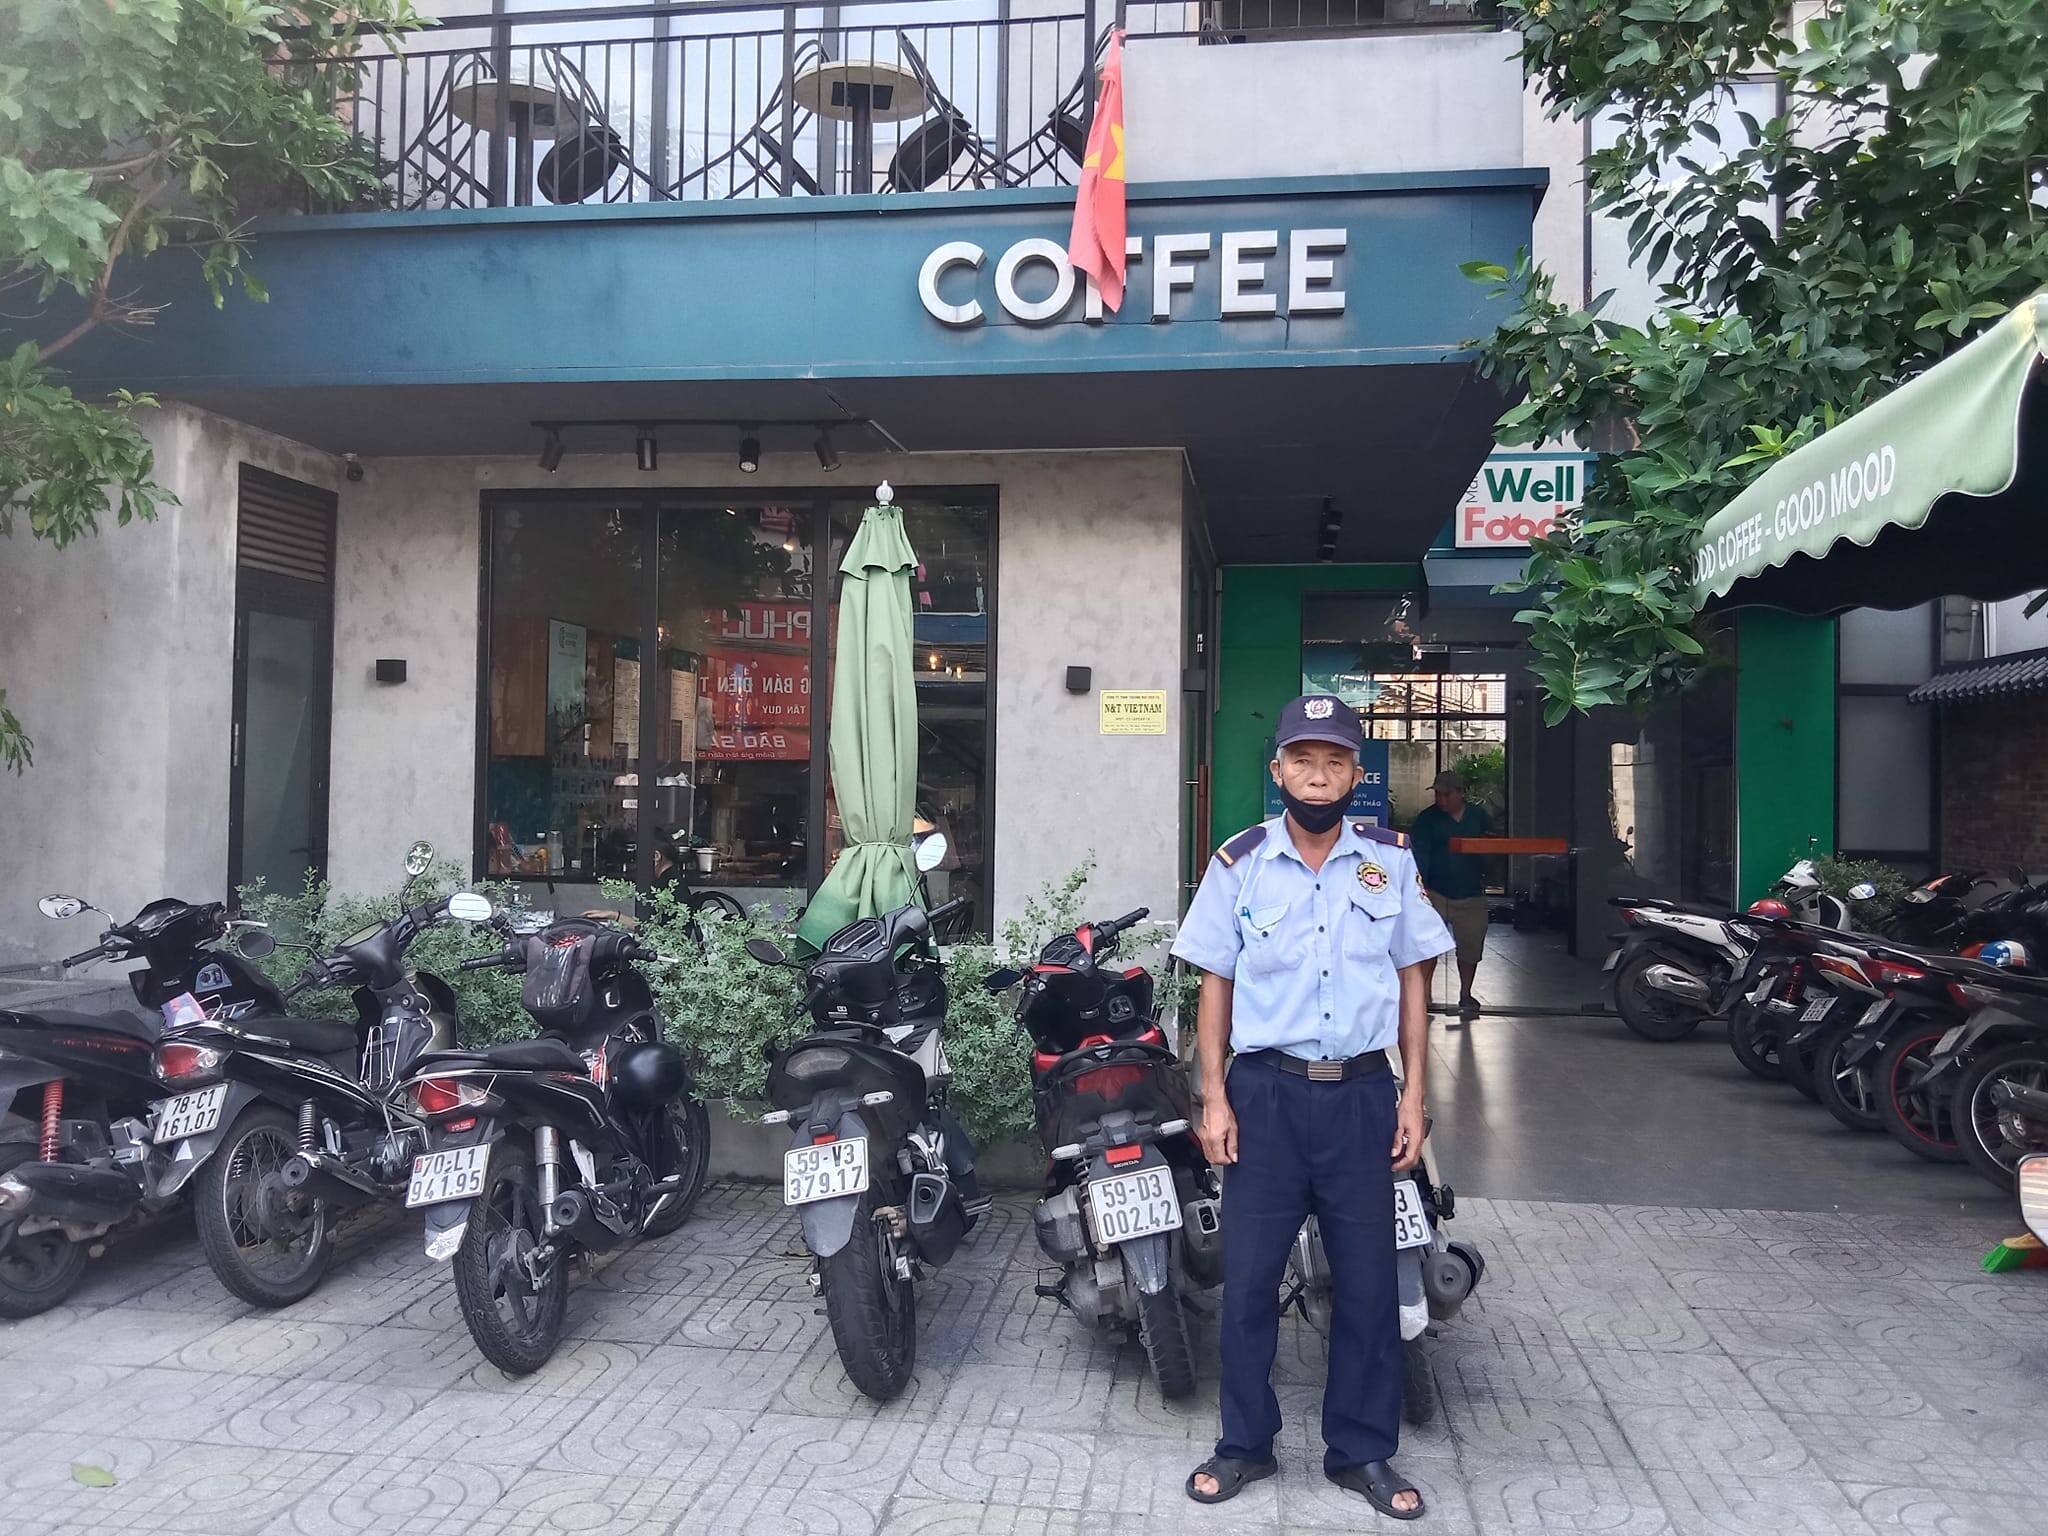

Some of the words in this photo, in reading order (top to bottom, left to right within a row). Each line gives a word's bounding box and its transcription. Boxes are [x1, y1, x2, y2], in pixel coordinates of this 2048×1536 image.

[1484, 465, 1575, 503] Well
[1718, 512, 1762, 572] COFFEE
[1774, 479, 1826, 542] GOOD
[1830, 444, 1896, 518] MOOD
[1104, 703, 1122, 714] N&T
[1124, 703, 1162, 714] VIETNAM
[172, 1089, 216, 1116] 78-C1
[162, 1108, 217, 1139] 161.07
[421, 1148, 476, 1178] 70-L1
[797, 1143, 855, 1174] 59-V3
[1113, 1159, 1140, 1169] HONDA
[410, 1169, 481, 1202] 941.95
[790, 1165, 863, 1200] 379.17
[1101, 1173, 1163, 1208] 59-D3
[1102, 1199, 1176, 1238] 002.42
